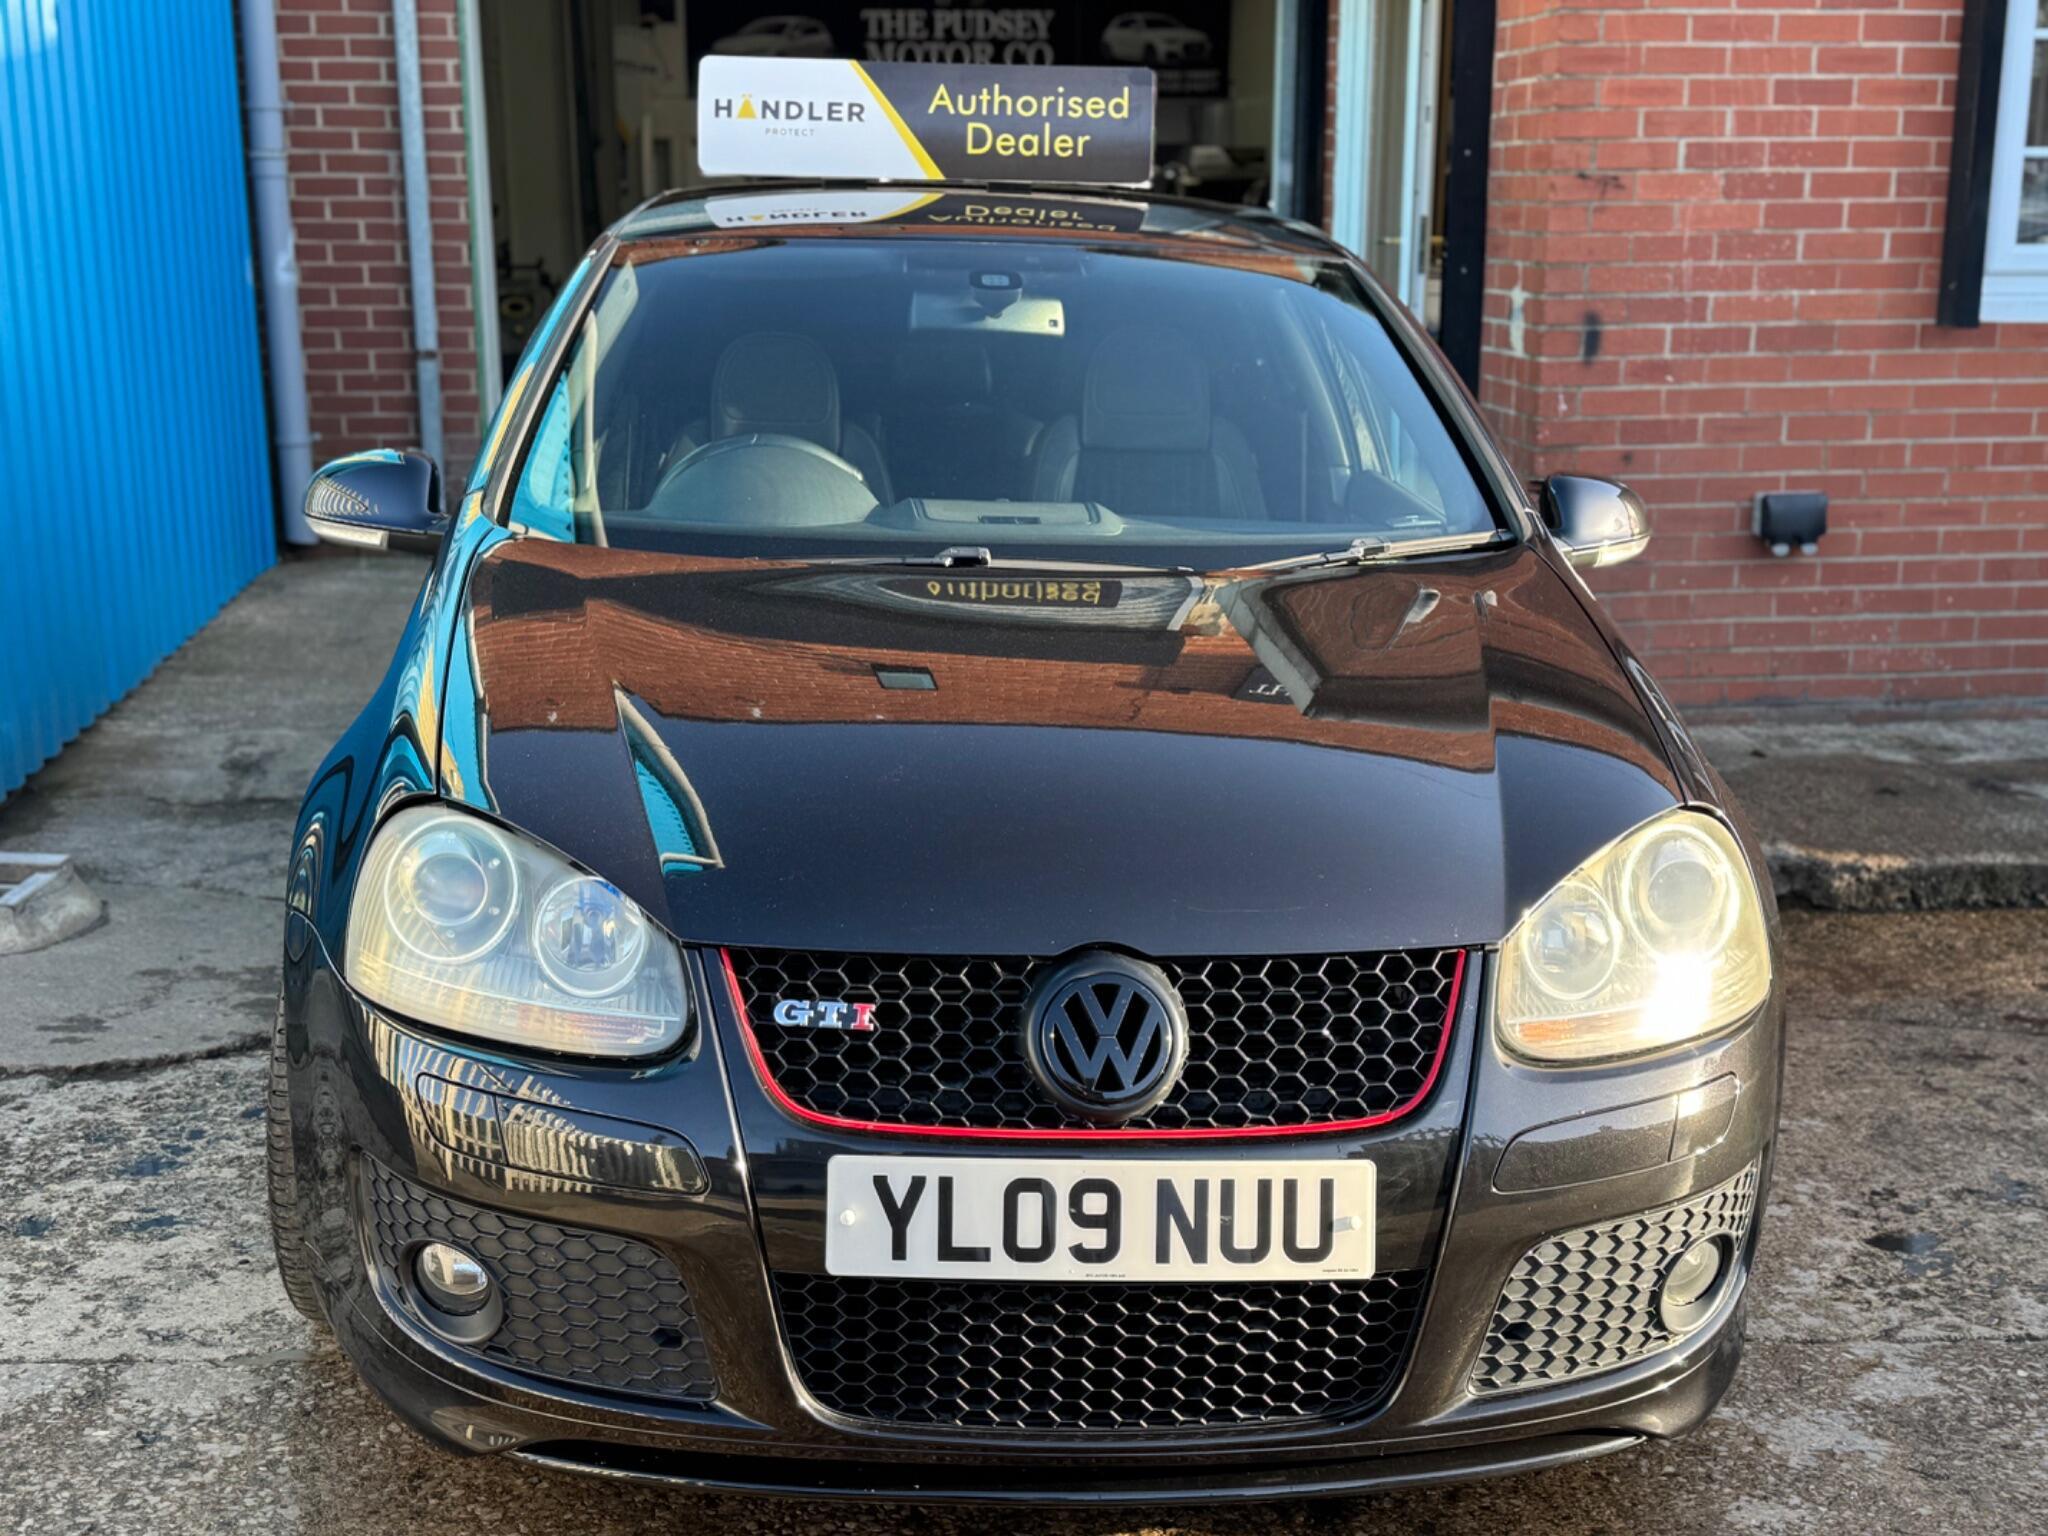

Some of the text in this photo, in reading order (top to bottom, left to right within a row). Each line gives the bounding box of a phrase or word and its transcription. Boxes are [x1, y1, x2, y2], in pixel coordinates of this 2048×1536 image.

[860, 9, 1055, 41] THE PUDSEY
[865, 41, 995, 64] MOTOR
[927, 83, 1129, 119] Authorised
[765, 128, 815, 137] PROTECT
[966, 121, 1091, 157] Dealer
[773, 999, 876, 1031] GTI
[872, 1175, 1335, 1264] YL09 NUU
